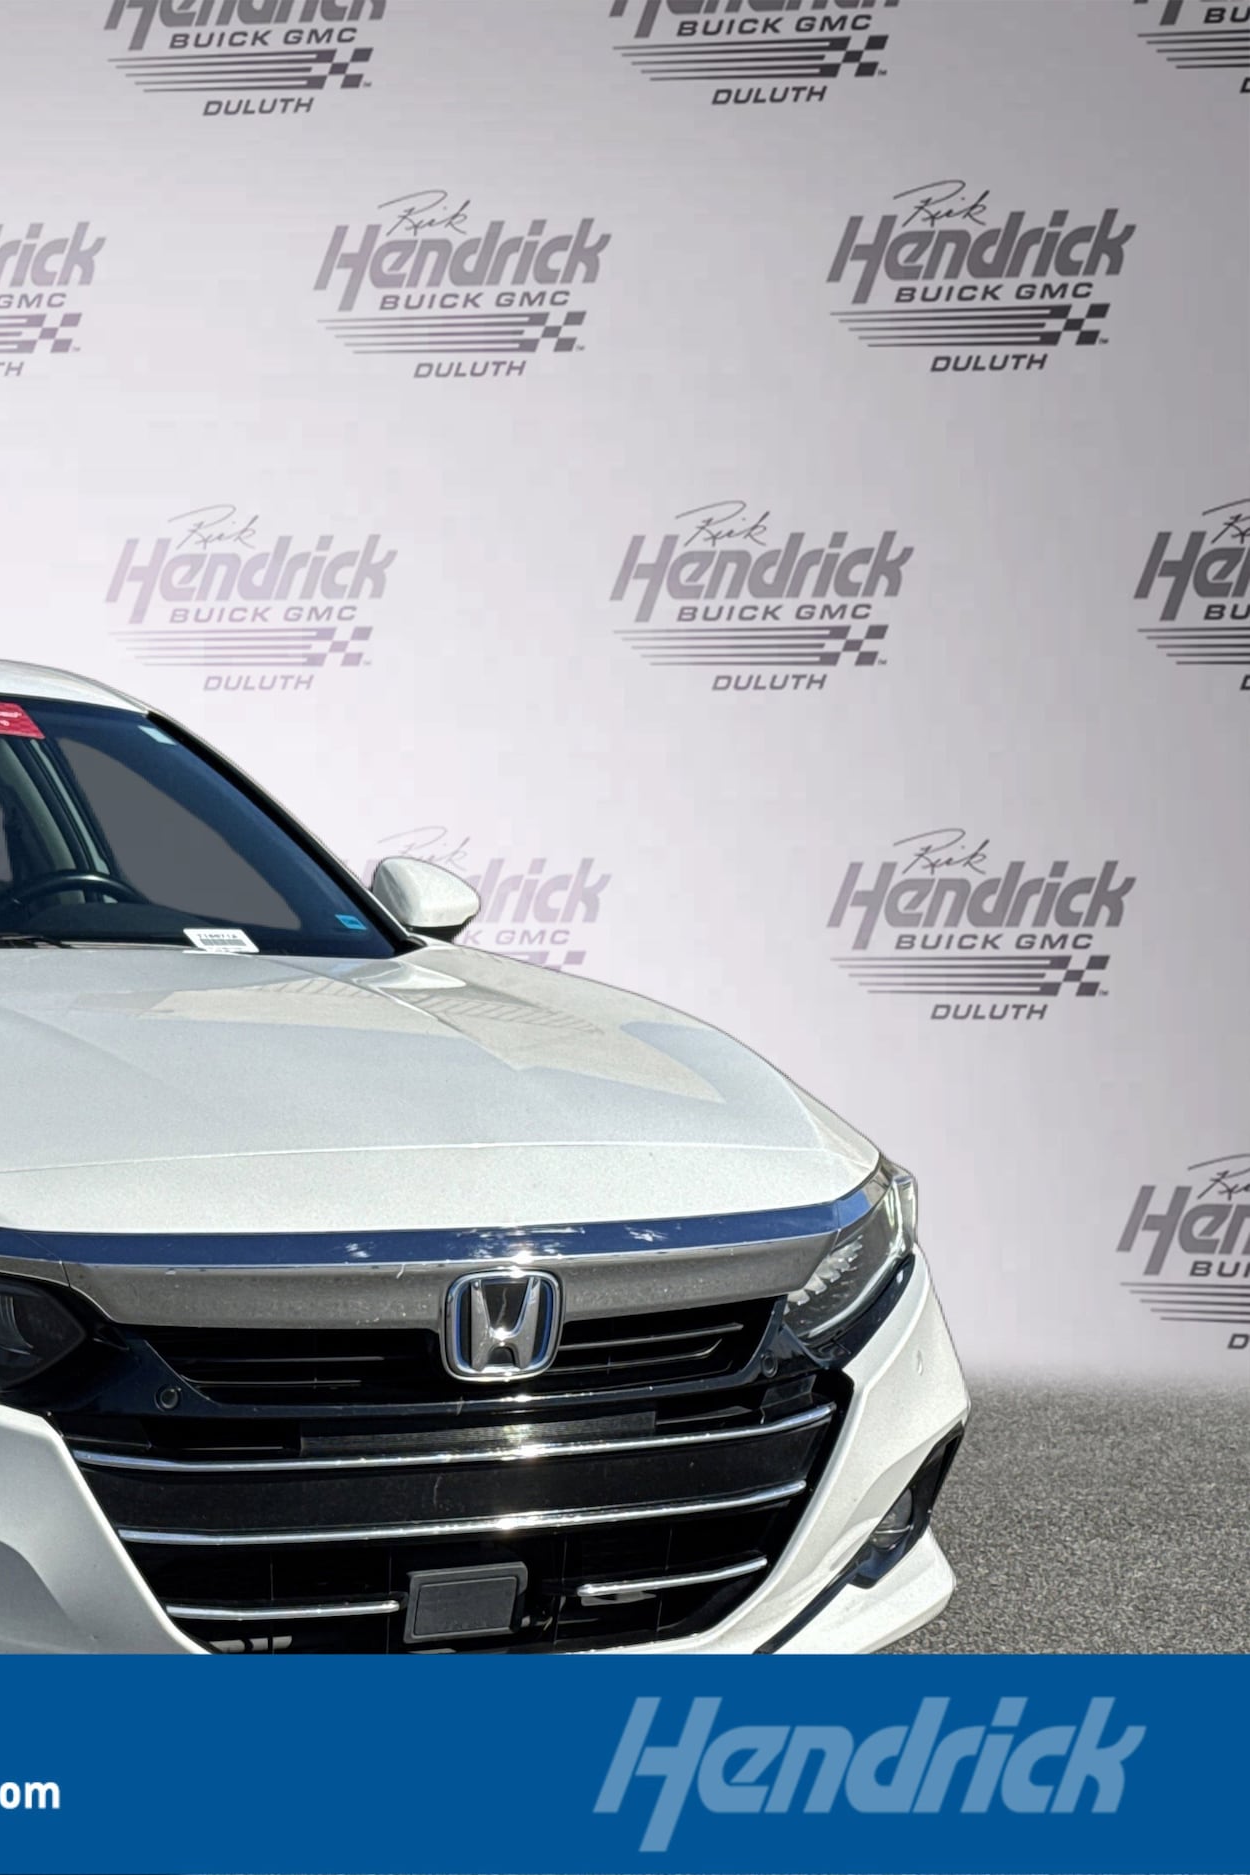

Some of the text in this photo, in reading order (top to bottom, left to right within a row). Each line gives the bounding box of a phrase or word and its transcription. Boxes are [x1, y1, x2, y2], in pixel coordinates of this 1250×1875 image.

[677, 17, 783, 37] BUICK
[795, 14, 872, 32] GMC
[169, 27, 357, 49] BUICK GMC
[712, 85, 827, 105] DULUTH
[203, 97, 314, 116] DULUTH
[312, 218, 611, 311] Hendrick
[826, 208, 1136, 304] Hendrick
[379, 290, 570, 310] BUICK GMC
[895, 282, 1093, 303] BUICK GMC
[414, 360, 526, 378] DULUTH
[931, 353, 1048, 372] DULUTH
[104, 534, 397, 624] Hendrick
[609, 530, 915, 623] Hendrick
[169, 605, 357, 623] BUICK GMC
[677, 603, 872, 622] BUICK GMC
[203, 674, 314, 691] DULUTH
[712, 674, 827, 690] DULUTH
[826, 860, 1136, 950] Hendrick
[495, 929, 570, 945] GMC
[895, 933, 1093, 950] BUICK GMC
[931, 1004, 1048, 1020] DULUTH
